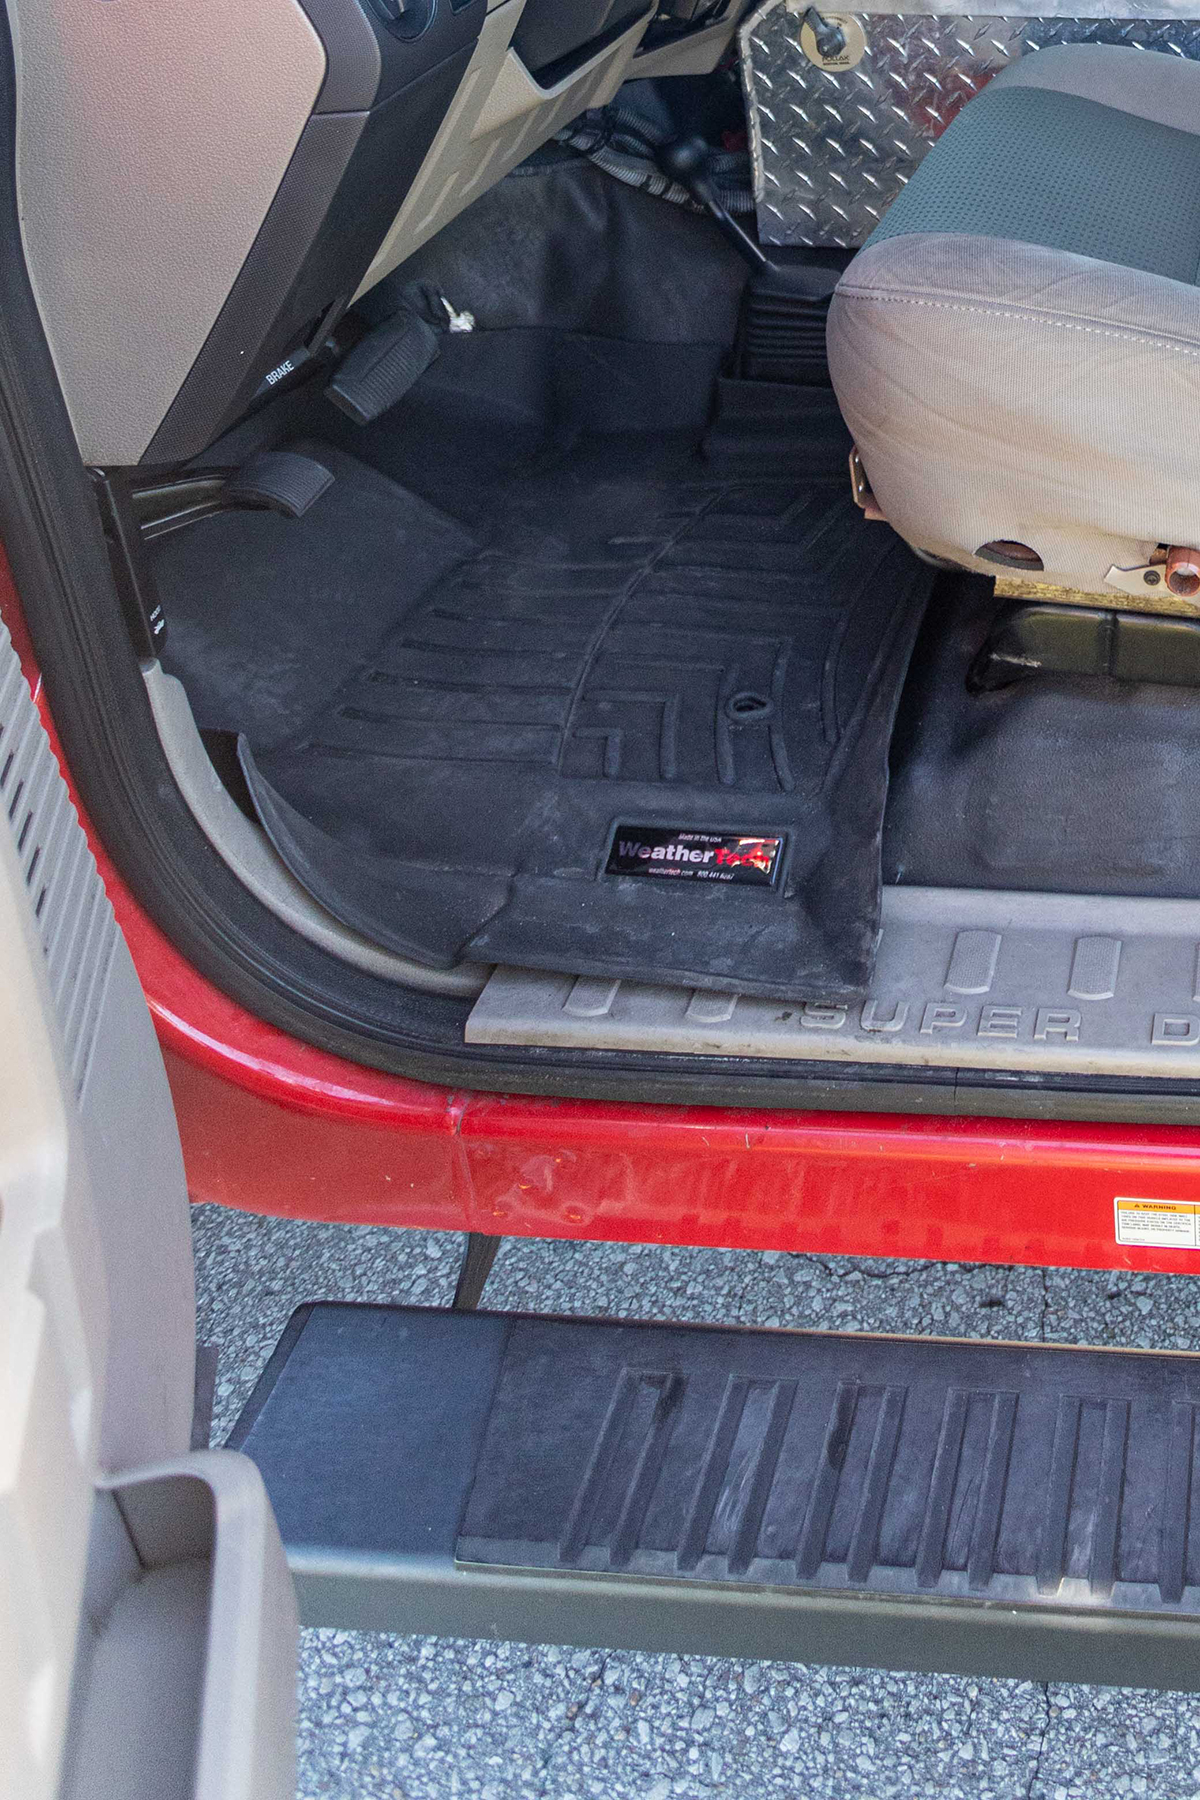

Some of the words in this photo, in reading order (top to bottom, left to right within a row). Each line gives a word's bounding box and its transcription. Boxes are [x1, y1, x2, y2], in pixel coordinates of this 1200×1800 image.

[265, 360, 294, 385] BRAKE
[618, 840, 770, 872] WeatherTech
[799, 1000, 1083, 1043] SUPER
